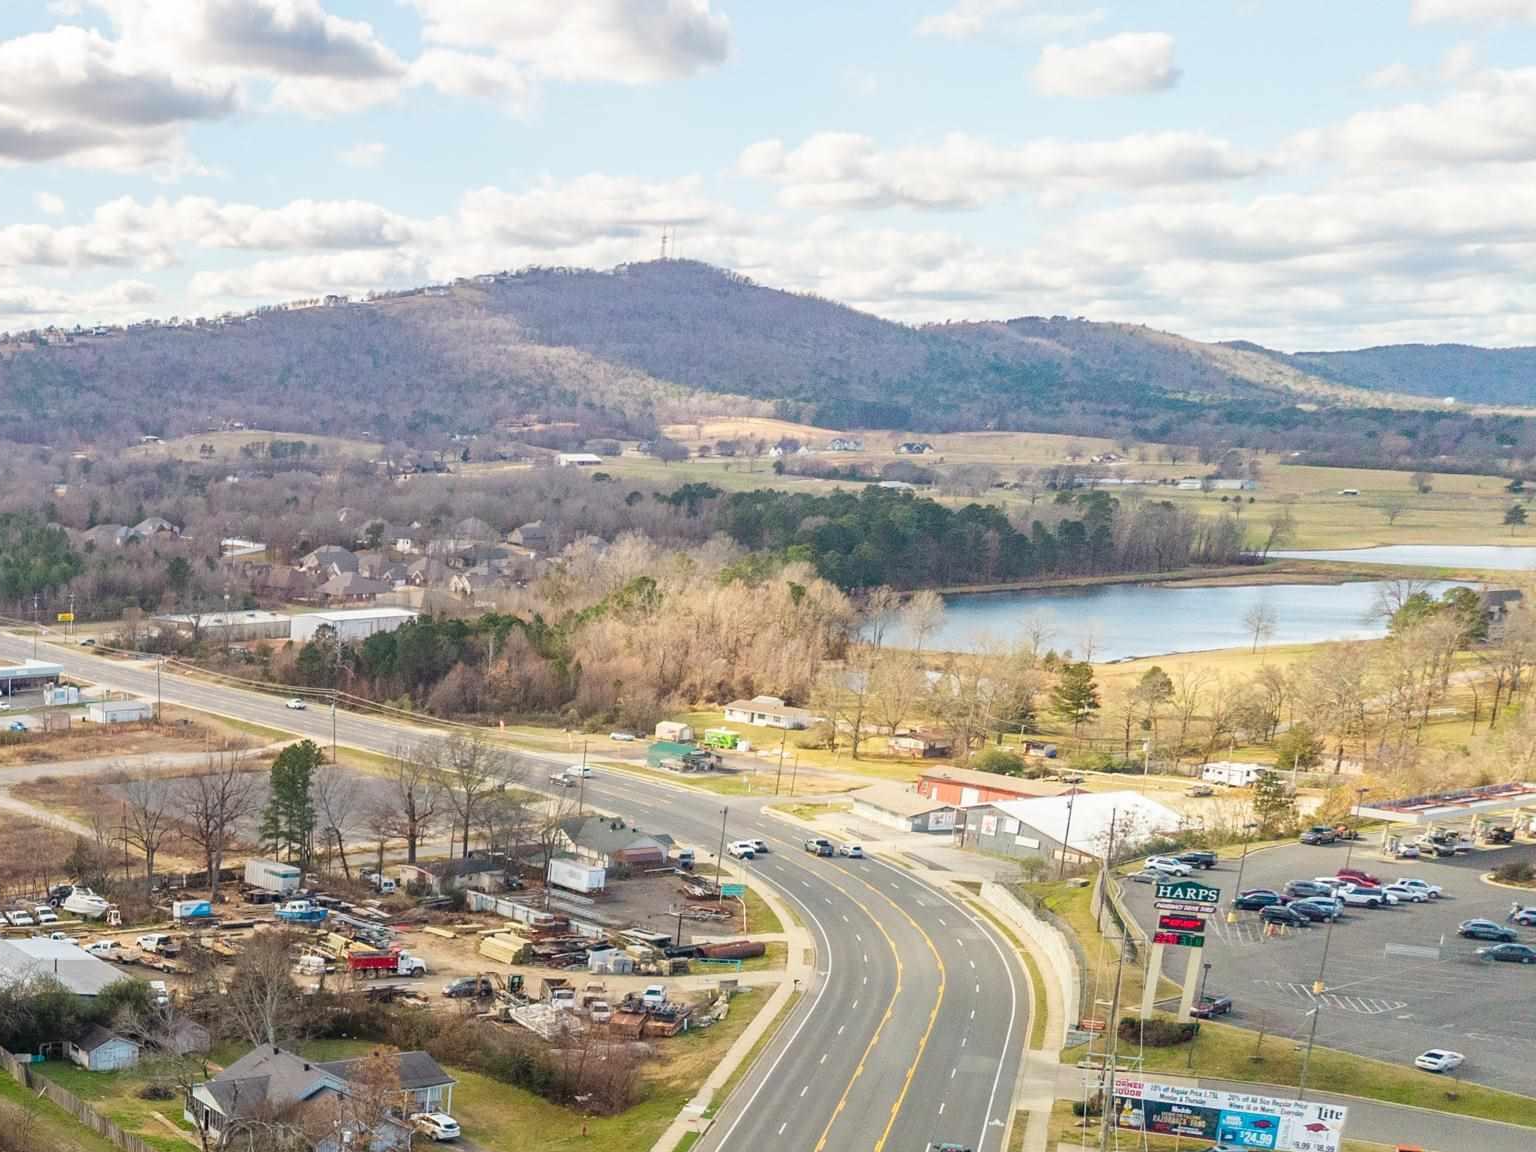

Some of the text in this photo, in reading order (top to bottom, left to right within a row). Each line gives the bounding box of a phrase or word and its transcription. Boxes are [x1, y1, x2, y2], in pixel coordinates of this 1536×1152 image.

[1158, 885, 1218, 901] HARPS
[1115, 1079, 1144, 1089] ORNER
[1318, 1107, 1343, 1121] Lite
[1240, 1131, 1273, 1145] $24.99
